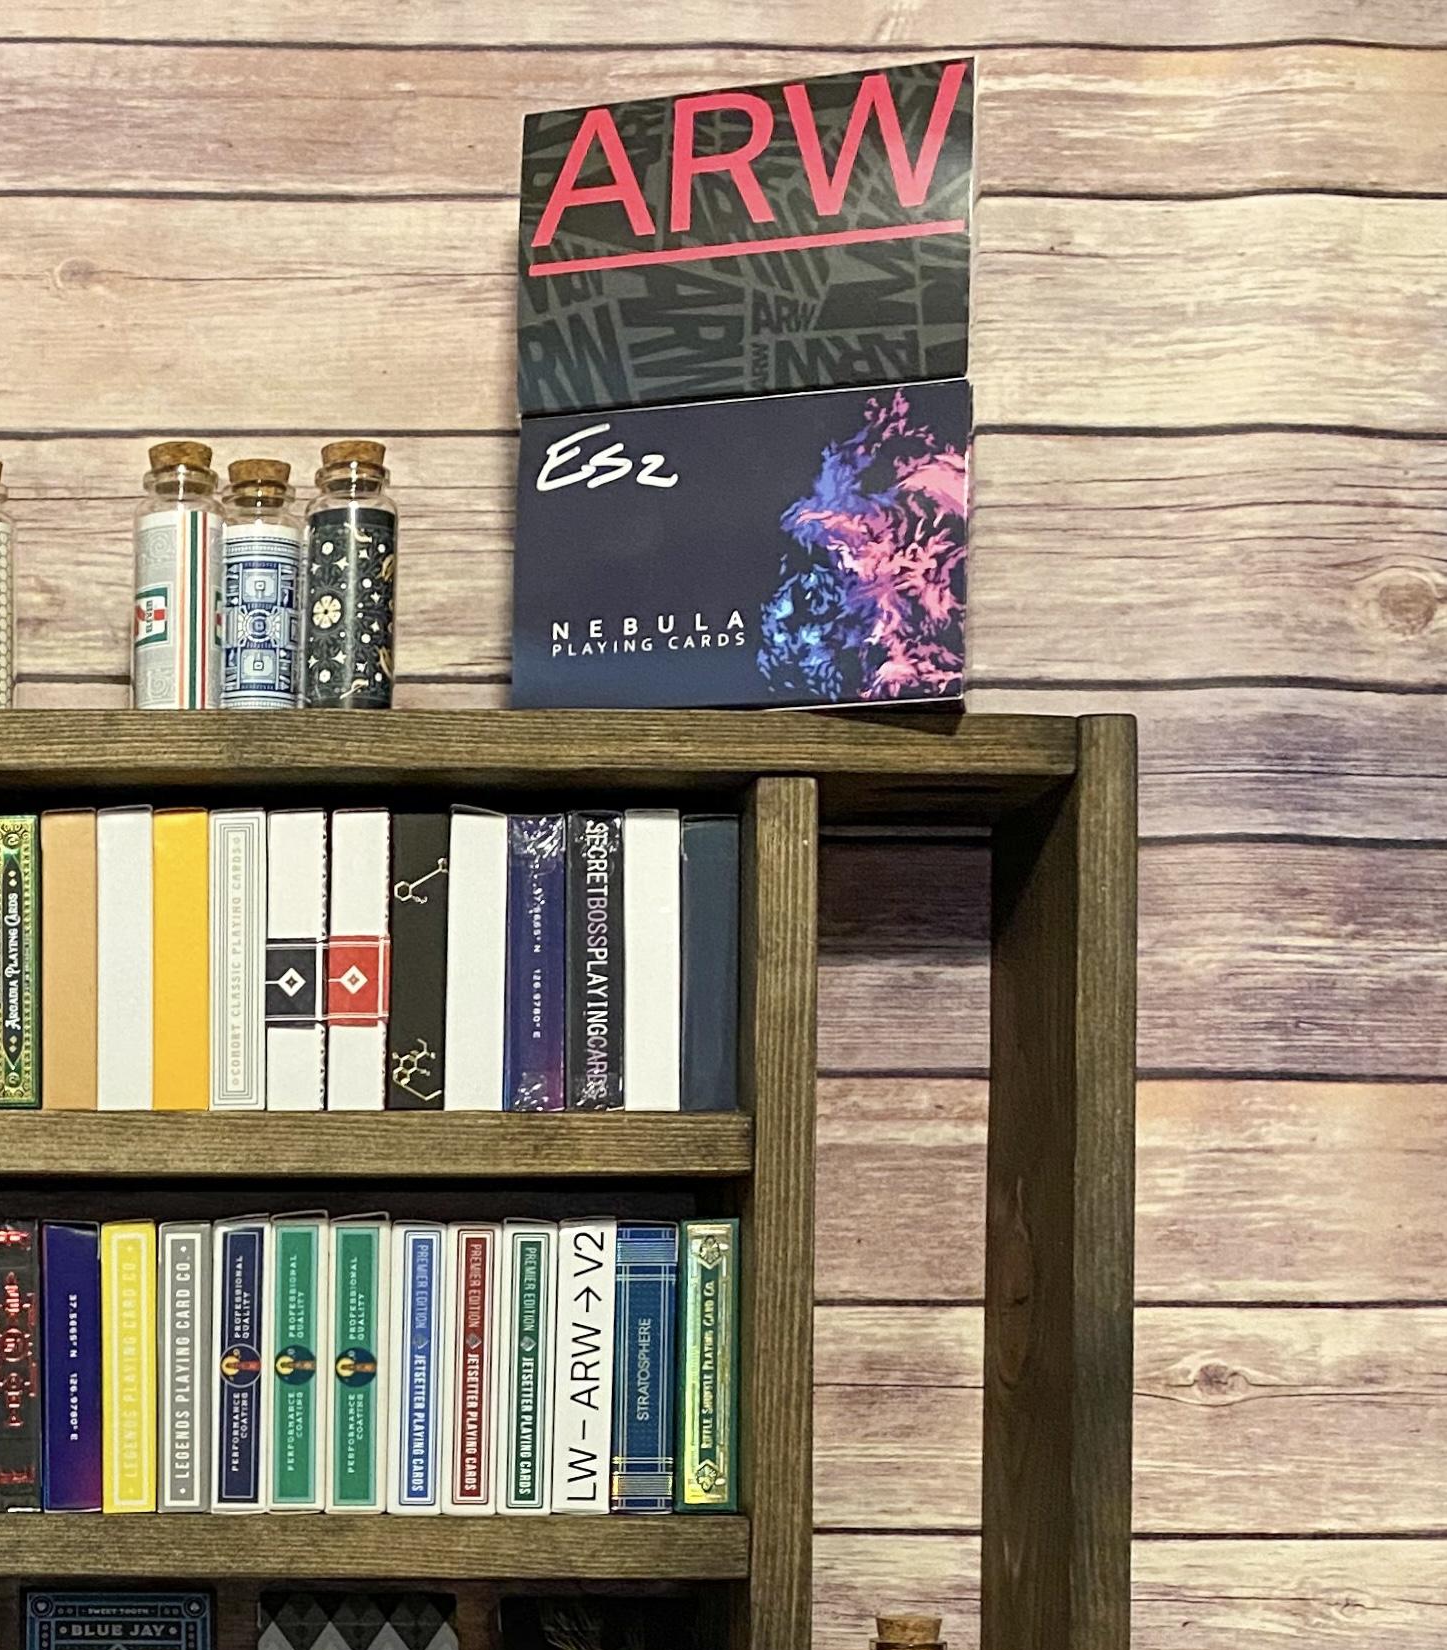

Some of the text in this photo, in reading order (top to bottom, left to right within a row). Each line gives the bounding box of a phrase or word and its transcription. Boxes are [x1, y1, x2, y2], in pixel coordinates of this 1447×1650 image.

[531, 62, 967, 247] ARW
[551, 632, 746, 657] PLAYING CARDS
[552, 609, 745, 641] NEBULA
[7, 928, 20, 975] PLAYING
[231, 848, 241, 1077] COHORT CLASSIC PLAYING CARDS
[9, 981, 20, 1030] ARCADIA
[176, 1289, 190, 1328] CARD
[234, 1257, 242, 1338] PROFESSIONAL
[242, 1293, 250, 1338] QUALITY
[468, 1244, 482, 1328] PREMIER EDITION
[176, 1337, 190, 1402] PLAYING
[567, 1231, 604, 1501] LW ARW V2
[637, 1318, 651, 1421] STRATOSPHERE
[175, 1411, 190, 1479] LEGENDS
[231, 1393, 240, 1472] PERFORMANCE
[464, 1354, 480, 1490] JETSETTER PLAYING CARDS
[72, 1625, 165, 1637] BLUE JAY
